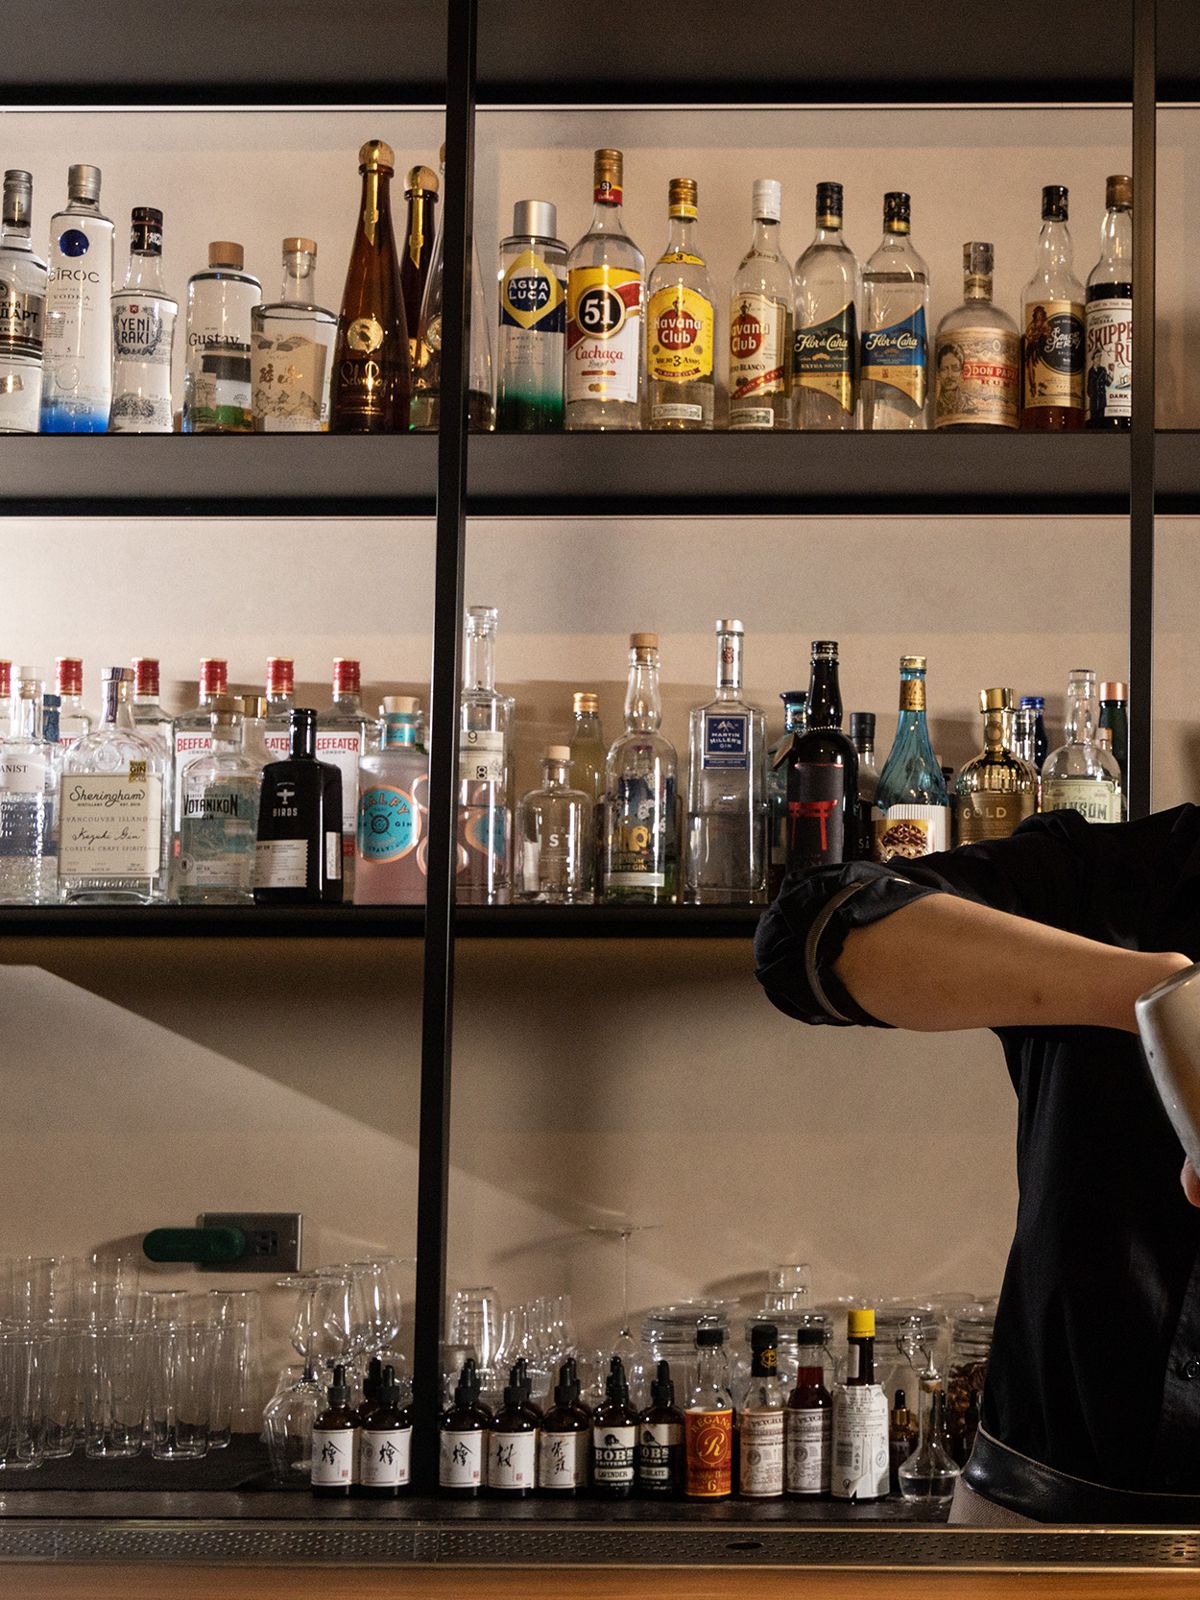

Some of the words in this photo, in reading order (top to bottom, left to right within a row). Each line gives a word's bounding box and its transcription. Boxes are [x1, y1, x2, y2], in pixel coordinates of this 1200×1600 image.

[509, 280, 549, 291] AGUA
[509, 289, 547, 302] LUCA
[584, 298, 616, 326] 51
[660, 329, 691, 344] Club
[673, 354, 682, 367] 3
[972, 365, 994, 377] DON
[468, 731, 478, 744] 9
[69, 785, 146, 808] Sheringham
[183, 793, 239, 817] VOTANIKON
[963, 806, 1008, 820] GOLD
